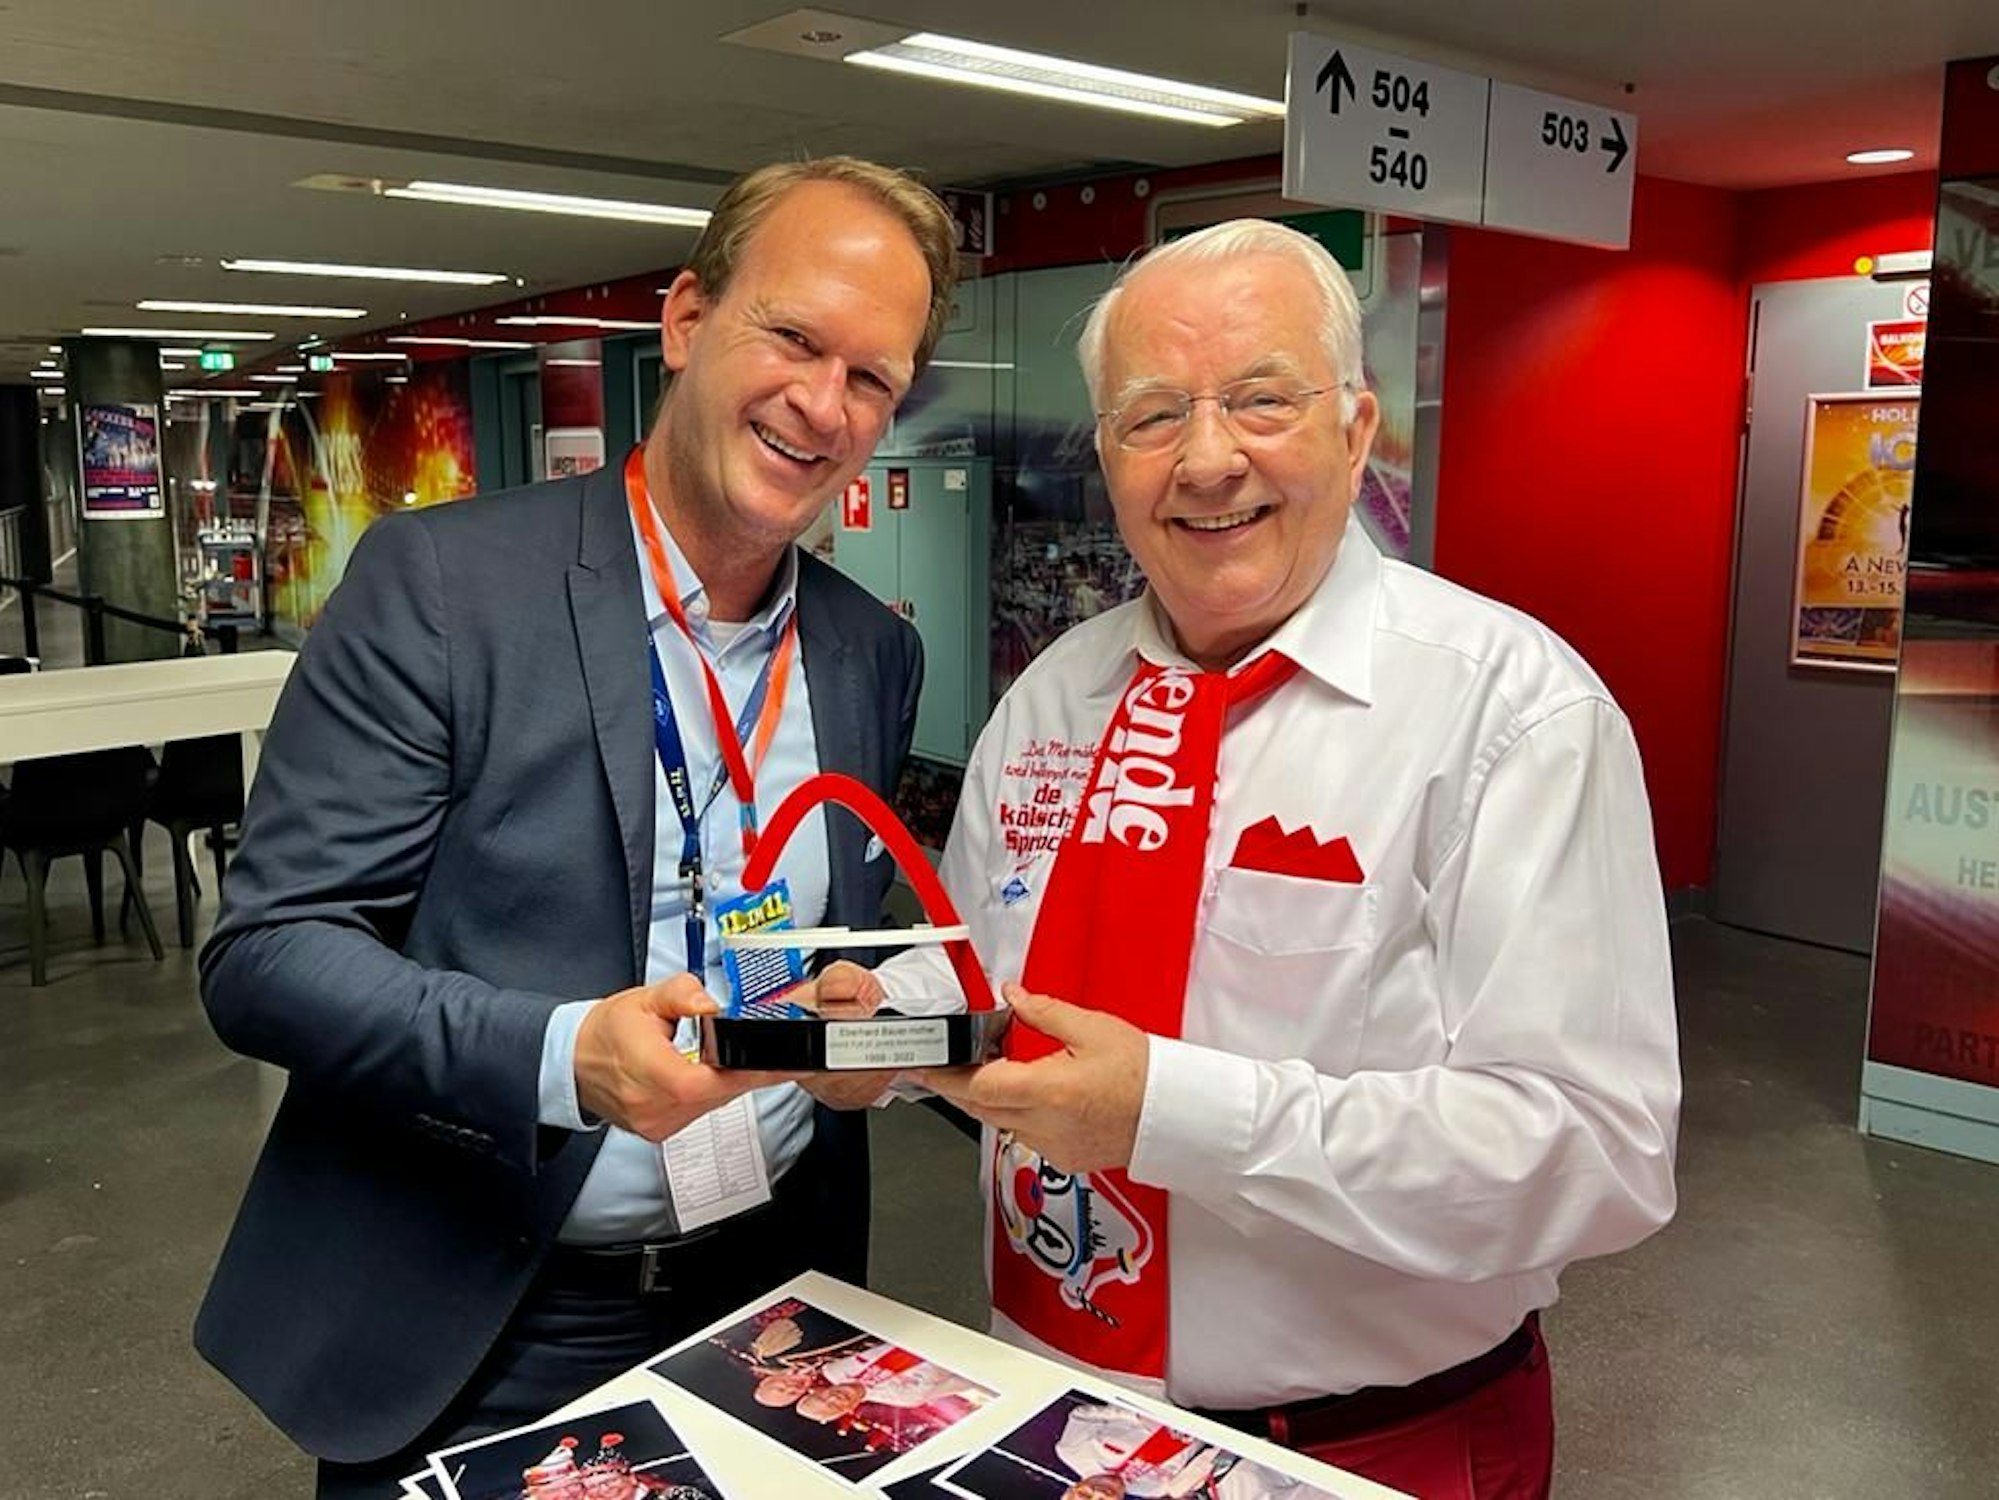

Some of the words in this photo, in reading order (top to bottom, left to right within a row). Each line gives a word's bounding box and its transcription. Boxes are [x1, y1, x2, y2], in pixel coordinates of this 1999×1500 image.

[1371, 70, 1430, 118] 504
[1541, 112, 1589, 153] 503
[1369, 146, 1428, 191] 540
[1844, 556, 1859, 572] A
[1033, 783, 1062, 805] de
[1904, 783, 1999, 831] AUS
